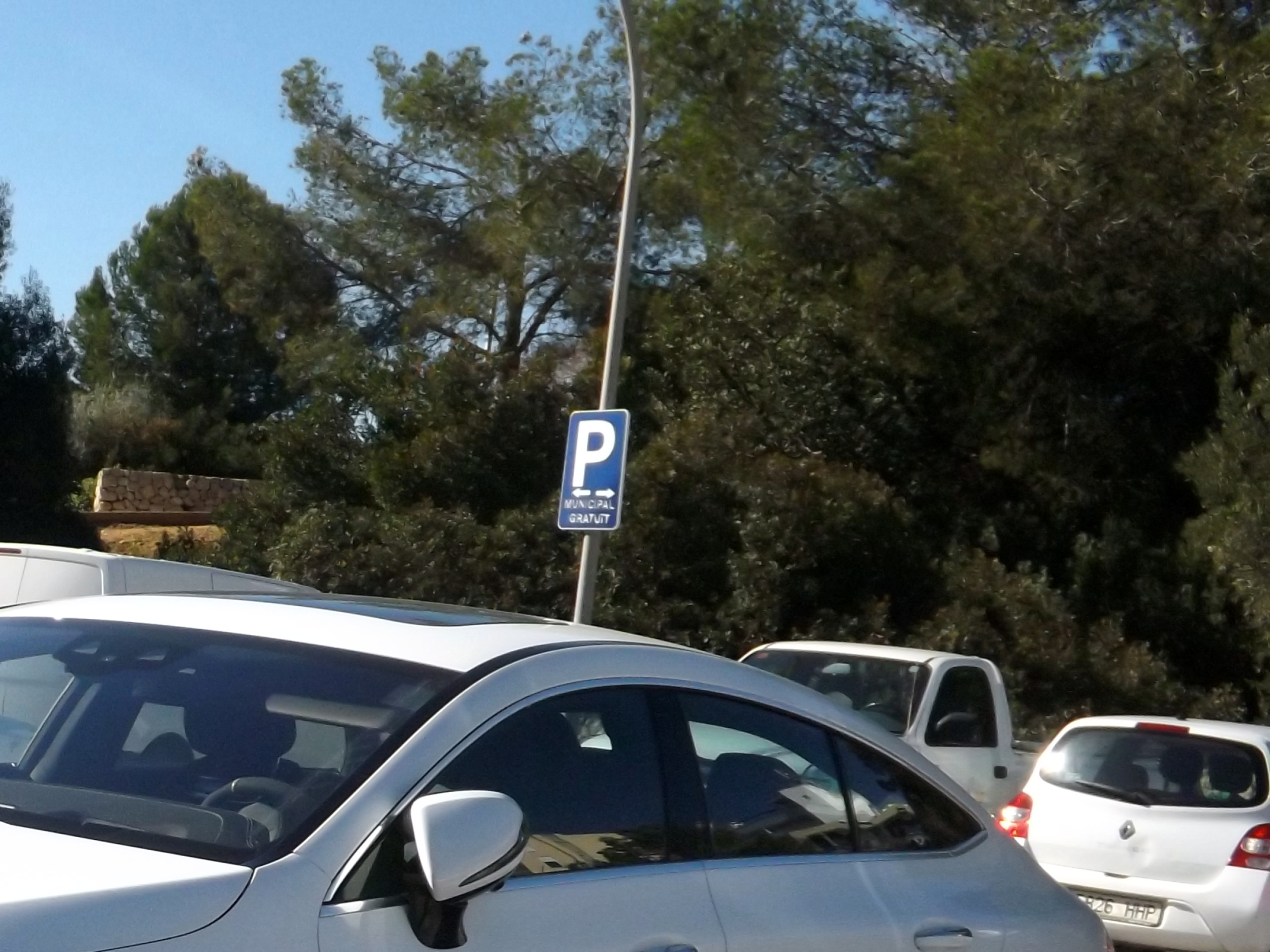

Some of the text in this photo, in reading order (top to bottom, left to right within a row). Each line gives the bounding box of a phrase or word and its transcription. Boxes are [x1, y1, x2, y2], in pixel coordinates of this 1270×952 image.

[571, 419, 616, 488] P
[564, 499, 616, 510] MUNICIPAL
[568, 512, 611, 525] GRATUIT
[1124, 901, 1156, 921] HHP
